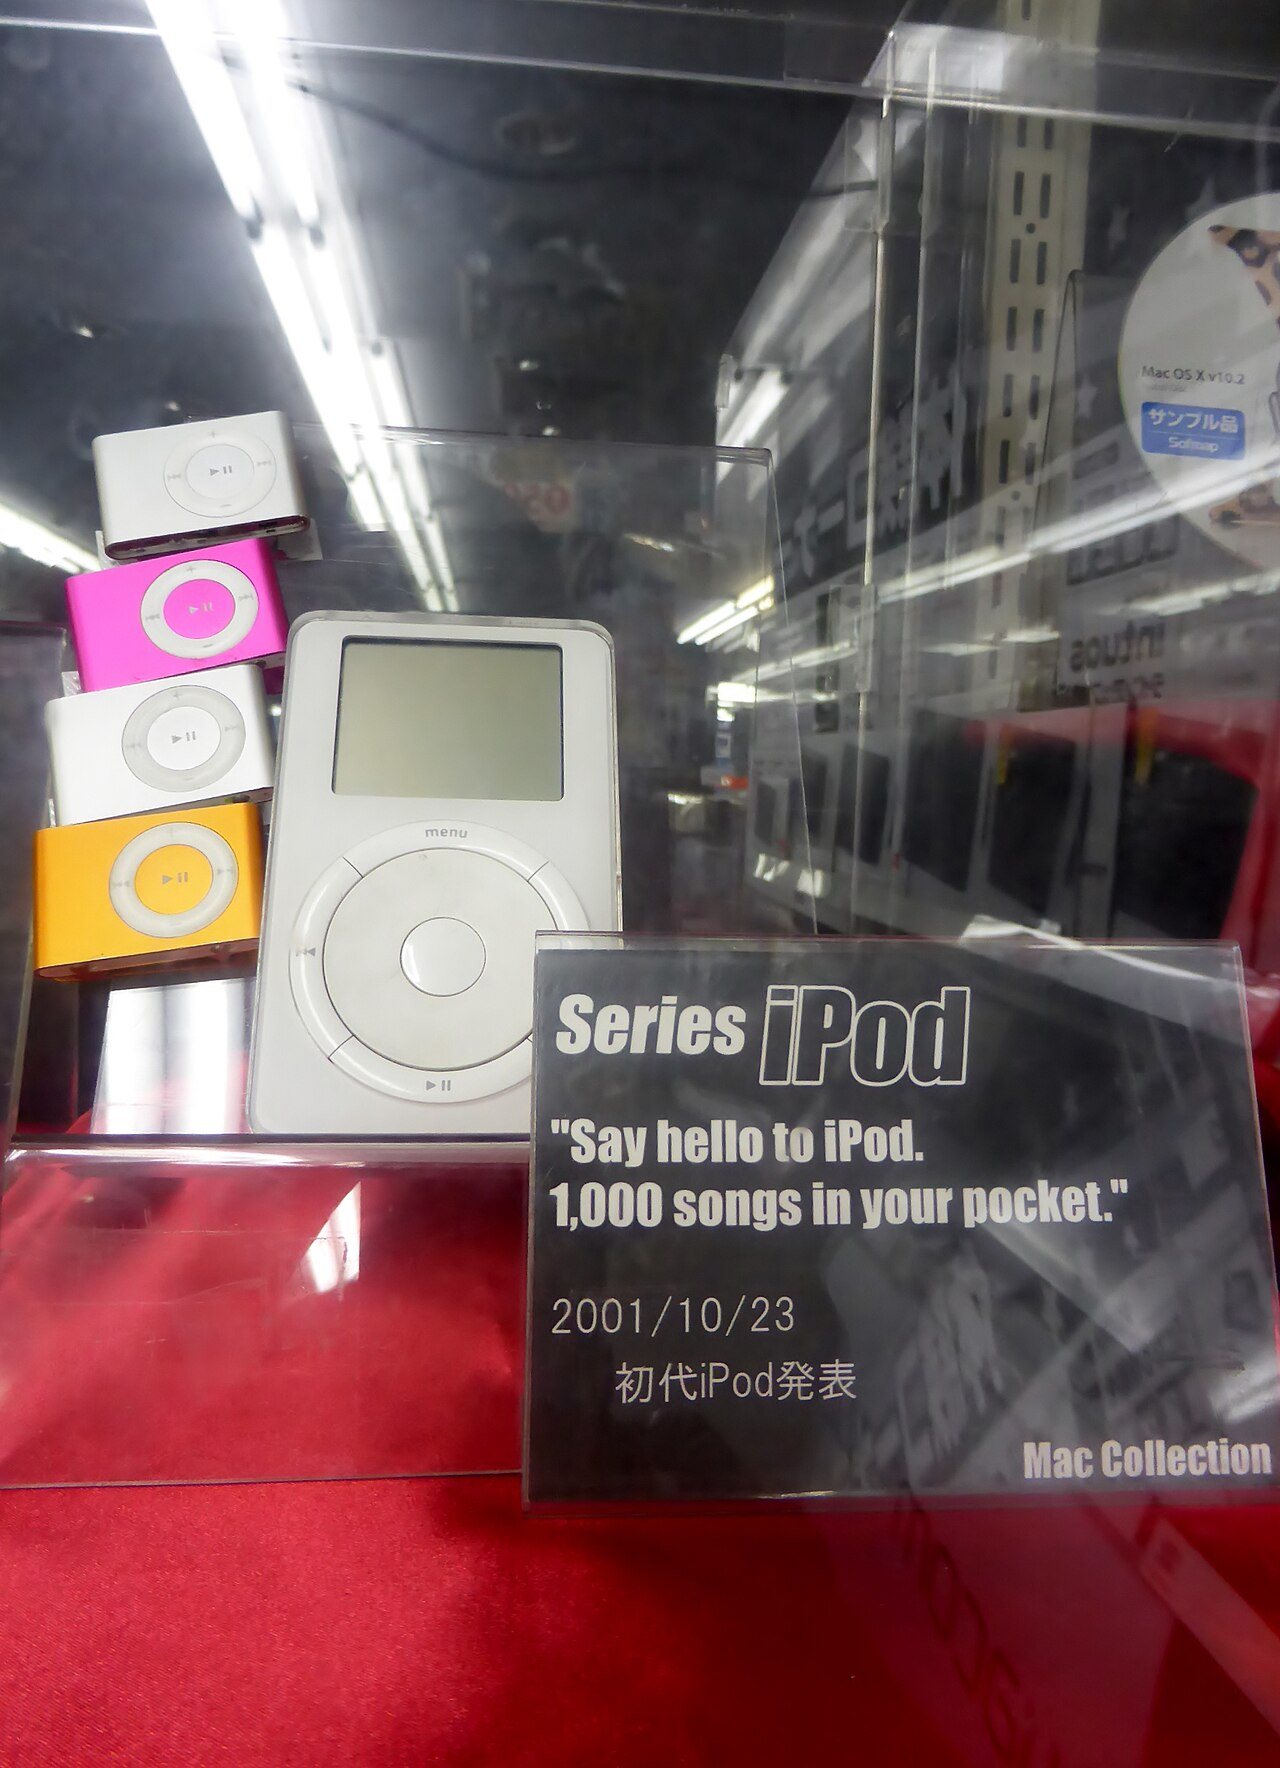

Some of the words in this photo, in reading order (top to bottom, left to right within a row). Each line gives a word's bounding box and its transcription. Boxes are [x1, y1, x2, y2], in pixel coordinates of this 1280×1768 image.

[1142, 366, 1170, 379] Mac
[1173, 368, 1193, 381] OS
[1196, 370, 1206, 382] X
[1208, 372, 1245, 384] v10.2
[425, 828, 468, 838] menu
[555, 993, 746, 1055] Series
[759, 984, 971, 1087] iPod
[551, 1118, 647, 1168] "Say
[656, 1119, 763, 1163] hello
[772, 1122, 814, 1163] to
[824, 1119, 924, 1162] iPod.
[550, 1181, 663, 1231] 1,000
[673, 1188, 801, 1231] songs
[812, 1181, 851, 1226] in
[860, 1187, 953, 1229] your
[963, 1178, 1128, 1228] pocket."
[551, 1294, 795, 1338] 2001/10/23
[615, 1358, 857, 1404] 初代iPod発表
[1023, 1441, 1094, 1479] Mac
[1100, 1437, 1273, 1478] Collection
